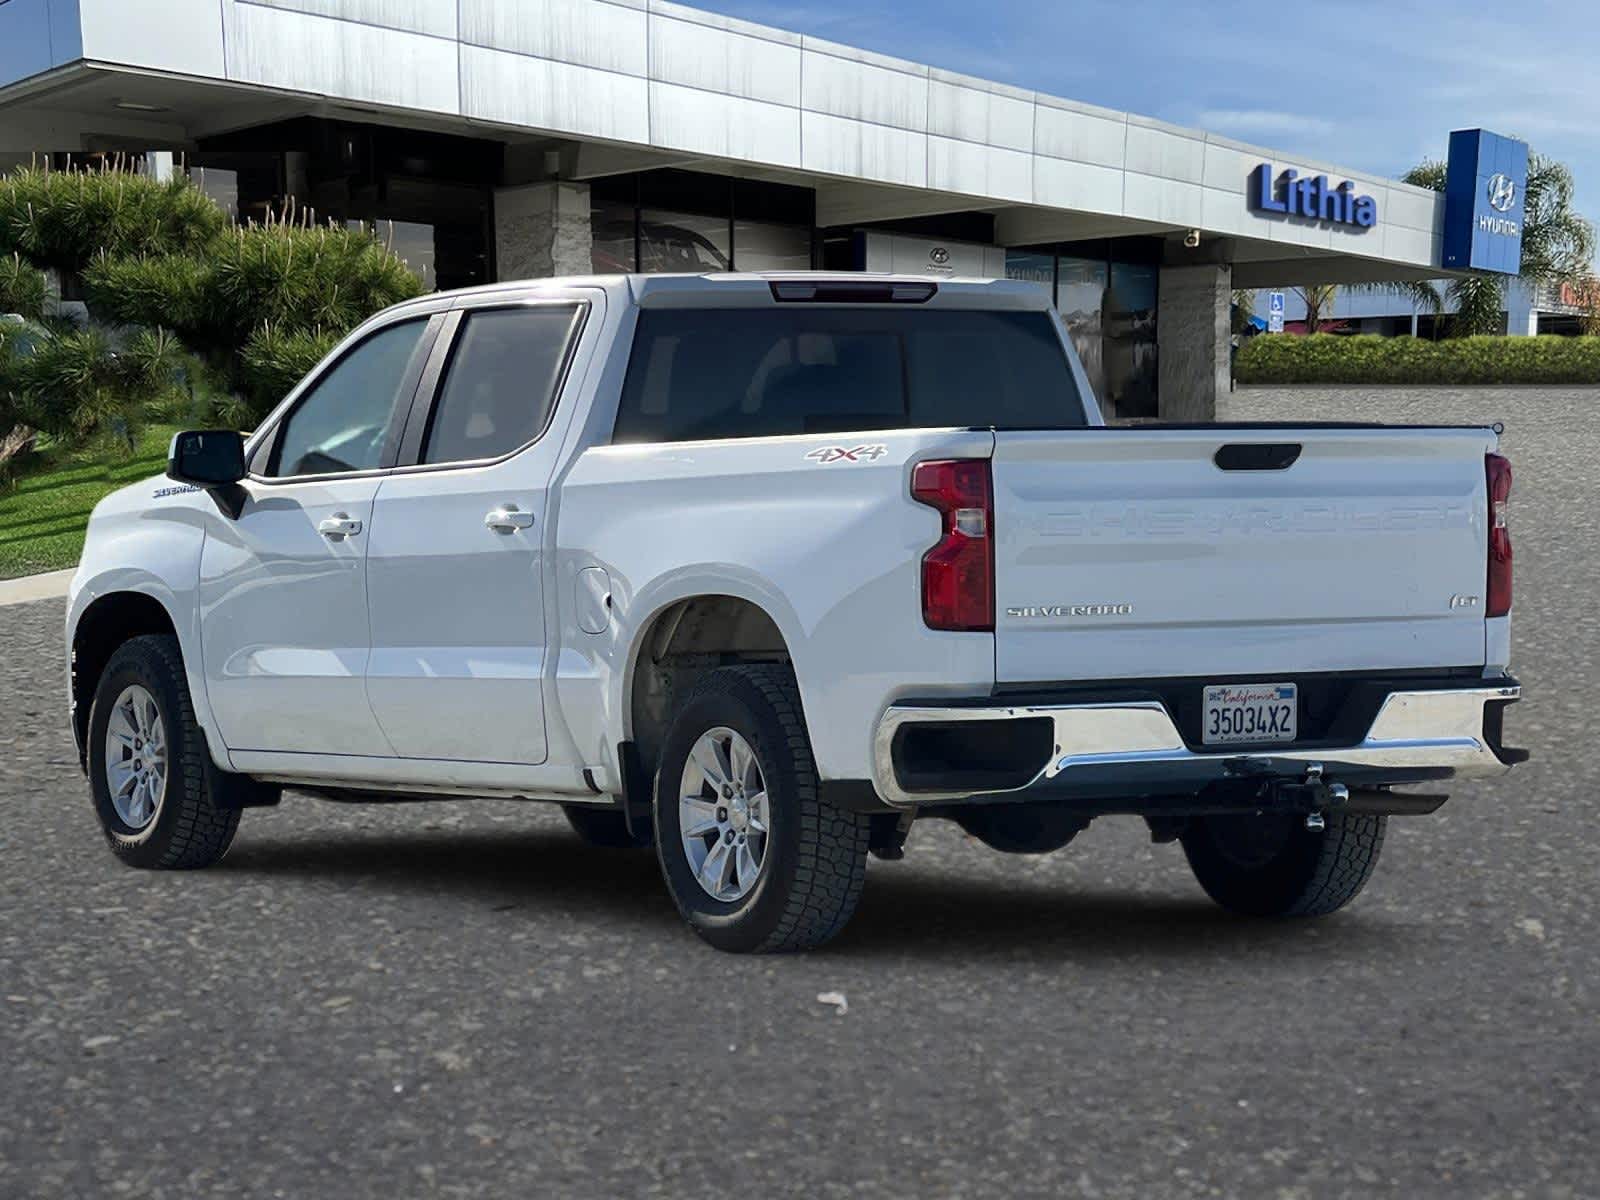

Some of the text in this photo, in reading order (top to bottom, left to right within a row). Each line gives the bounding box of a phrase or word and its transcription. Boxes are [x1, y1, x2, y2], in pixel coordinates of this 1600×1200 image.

[1252, 163, 1377, 228] Lithia
[1479, 215, 1521, 238] HYUNDAI
[1006, 605, 1133, 617] SILVERADO
[1223, 689, 1275, 705] California
[1209, 705, 1291, 735] 35034X2
